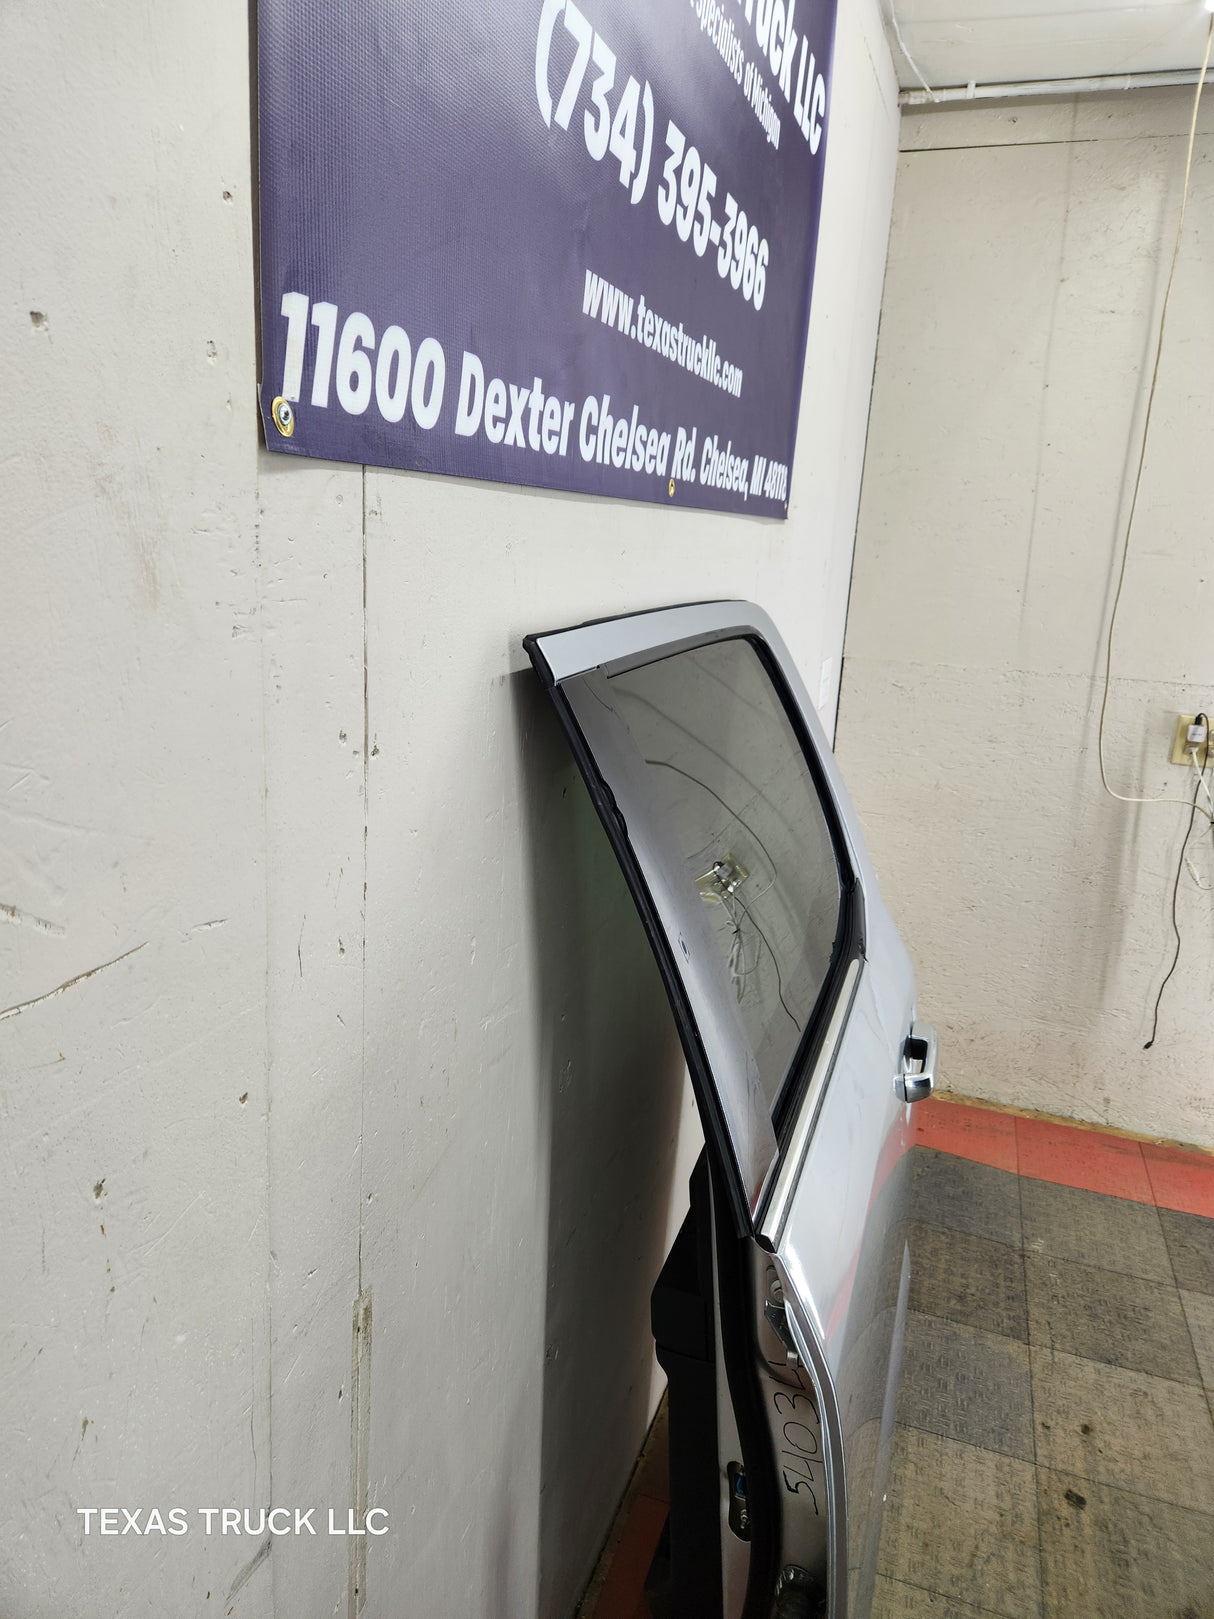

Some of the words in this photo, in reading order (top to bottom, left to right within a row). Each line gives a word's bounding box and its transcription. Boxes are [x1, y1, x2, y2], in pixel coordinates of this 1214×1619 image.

[737, 0, 798, 103] uck
[793, 34, 826, 155] LLC
[743, 62, 755, 102] of
[751, 66, 781, 150] Michigan
[535, 0, 654, 204] (734)
[657, 119, 769, 311] 395-3966
[280, 291, 446, 430] 11600
[454, 350, 576, 457] Dexter
[579, 394, 672, 478] Chelsea
[671, 426, 698, 483] Rd.
[699, 435, 749, 501] Chelsea,
[749, 454, 768, 497] MI
[763, 459, 788, 502] 48118
[582, 269, 743, 398] www.texastruckllc.com
